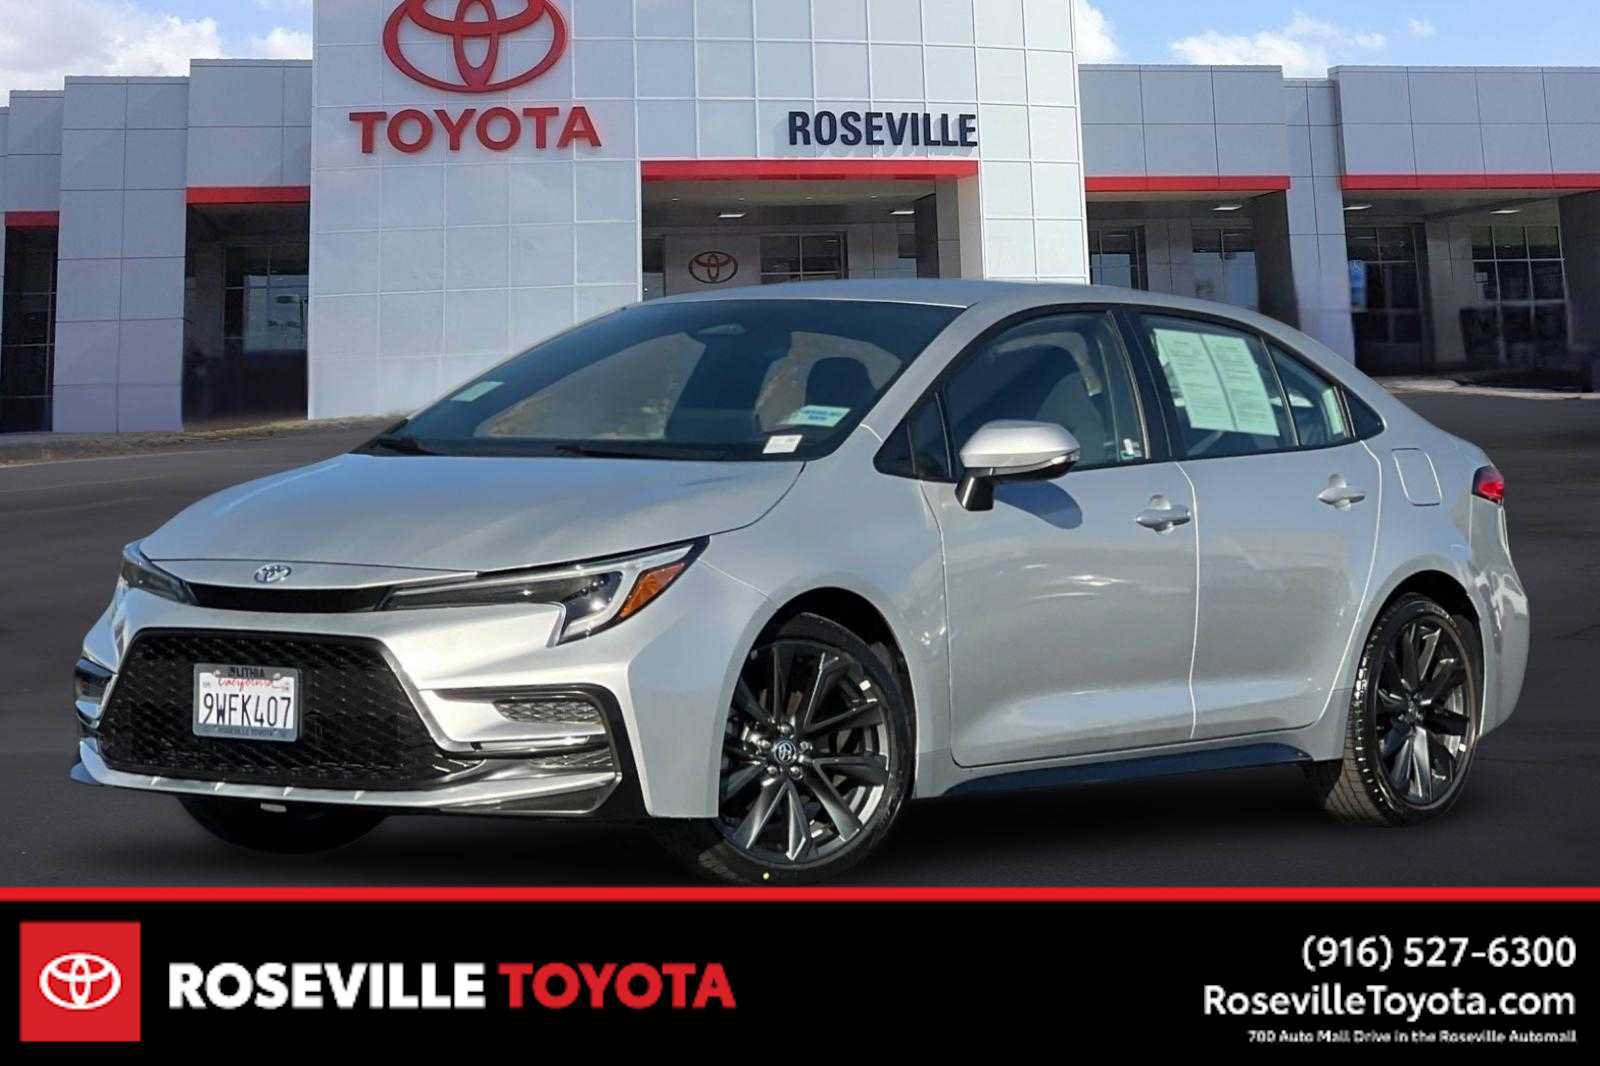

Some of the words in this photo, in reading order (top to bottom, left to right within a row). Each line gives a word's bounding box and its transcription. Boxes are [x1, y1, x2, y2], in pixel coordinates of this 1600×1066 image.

[349, 106, 603, 153] TOYOTA
[788, 111, 978, 148] ROSEVILLE
[203, 693, 291, 729] 9WFK407
